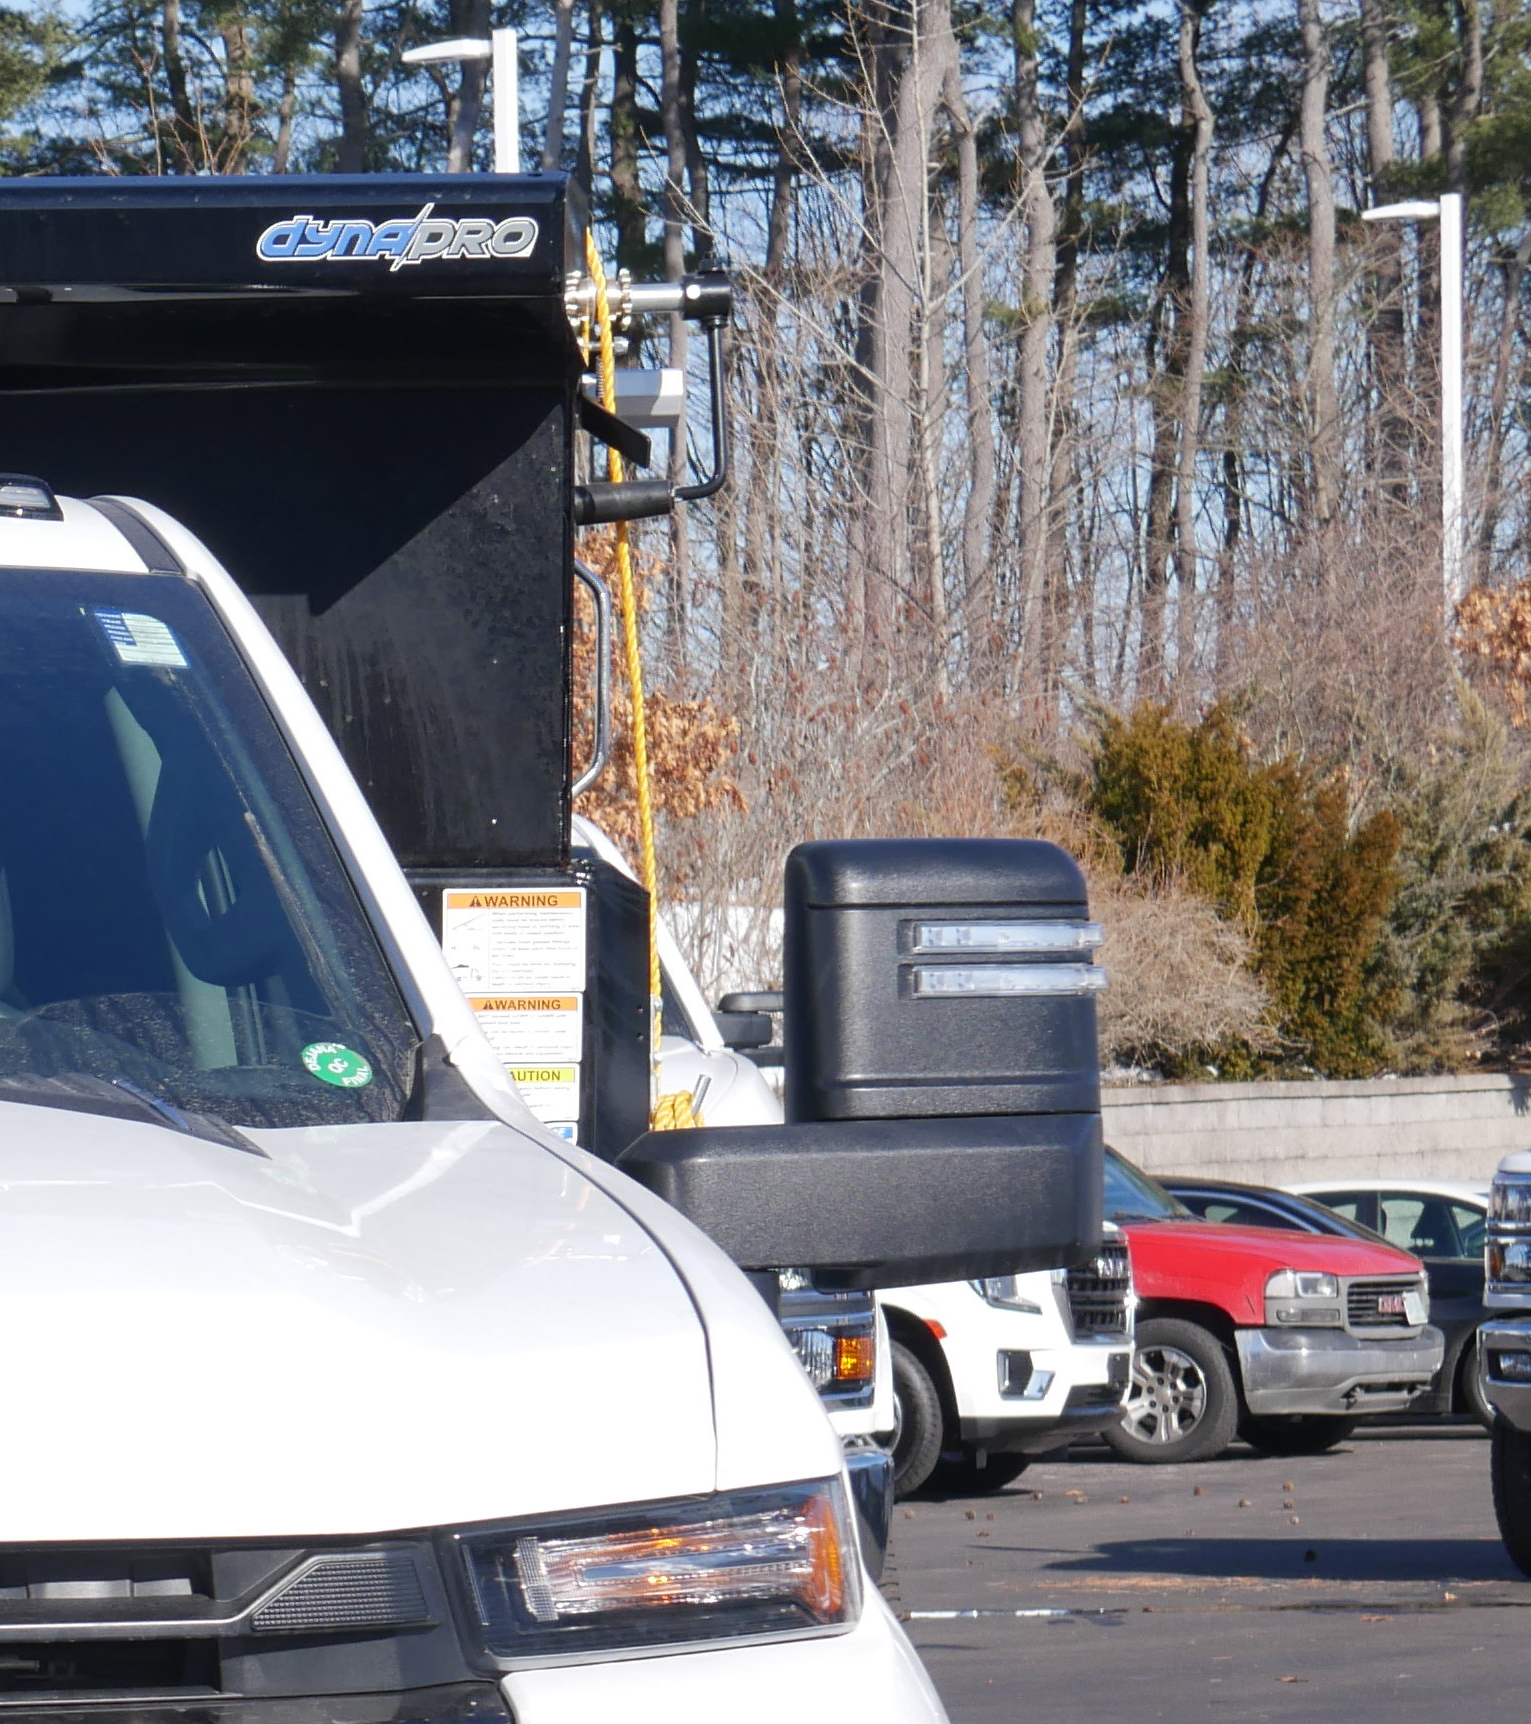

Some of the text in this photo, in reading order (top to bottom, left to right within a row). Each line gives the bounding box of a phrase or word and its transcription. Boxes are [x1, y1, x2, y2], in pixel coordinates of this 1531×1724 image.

[484, 894, 558, 907] WARNING
[494, 999, 561, 1010] WARNING
[327, 1057, 349, 1074] QC
